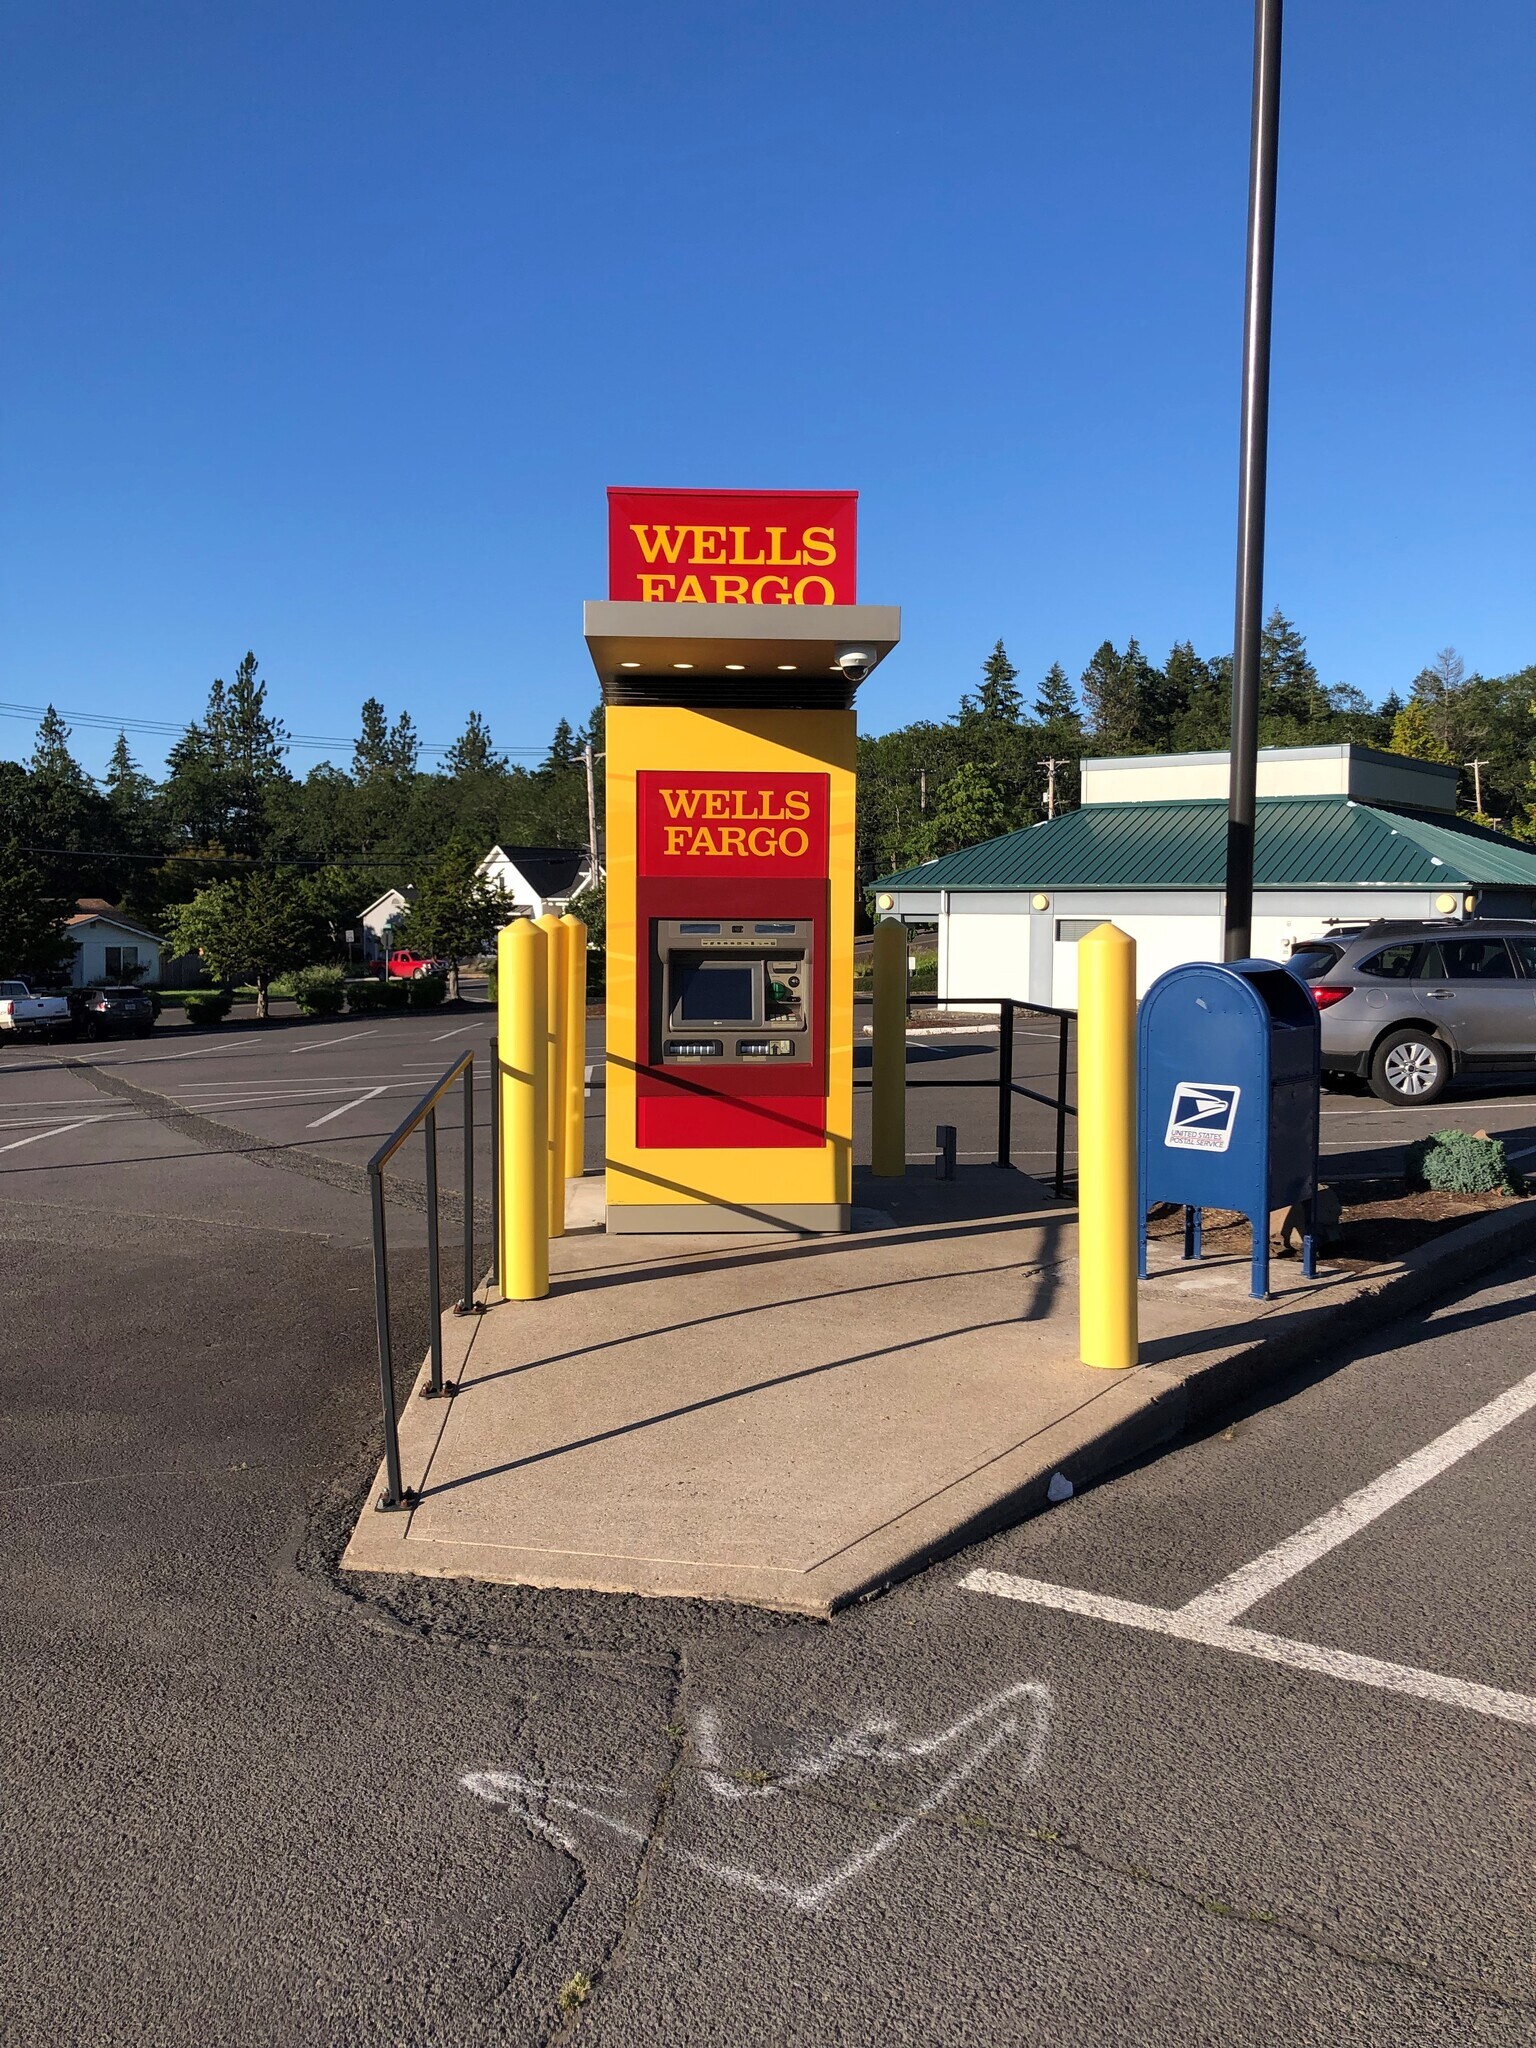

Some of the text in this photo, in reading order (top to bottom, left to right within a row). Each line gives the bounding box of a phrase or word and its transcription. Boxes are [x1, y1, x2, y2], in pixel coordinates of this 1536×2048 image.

[629, 524, 837, 566] WELLS
[636, 574, 835, 605] FARGO
[659, 789, 811, 821] WELLS
[663, 826, 809, 857] FARGO
[1170, 1137, 1224, 1148] POSTAL SERVICE
[1171, 1130, 1223, 1140] UNITED STATES
